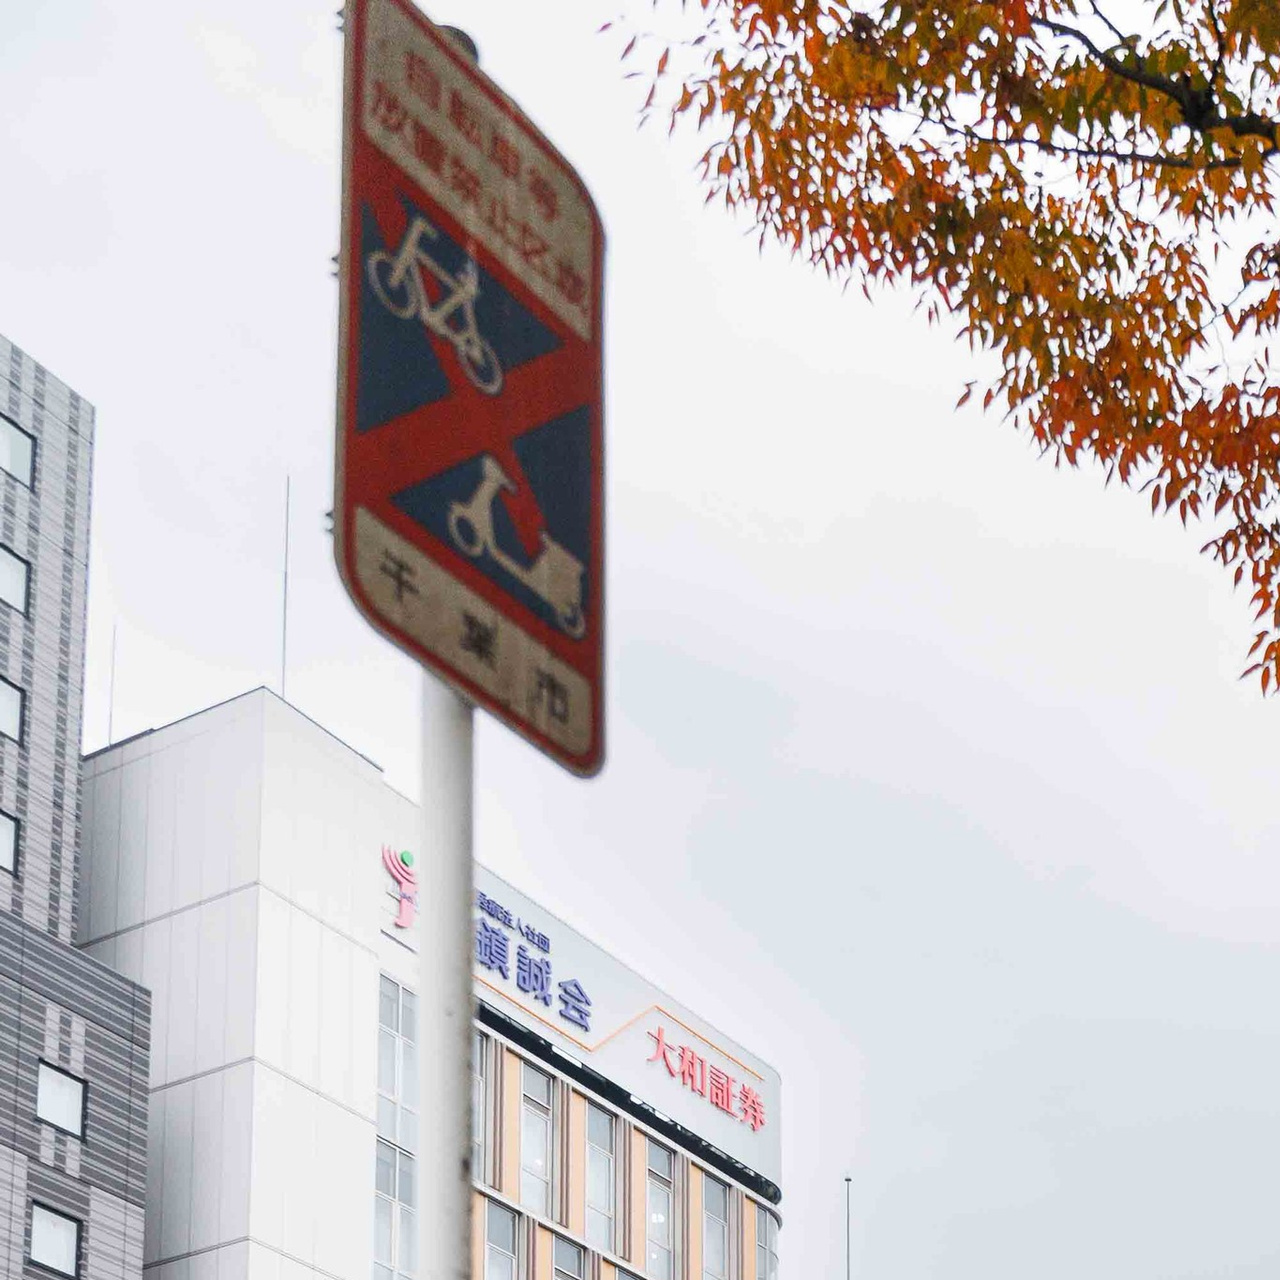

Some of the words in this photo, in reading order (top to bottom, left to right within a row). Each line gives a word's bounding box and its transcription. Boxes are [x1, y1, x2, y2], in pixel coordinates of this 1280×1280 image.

[379, 548, 571, 727] 千葉市
[646, 1025, 767, 1133] 大和証券
